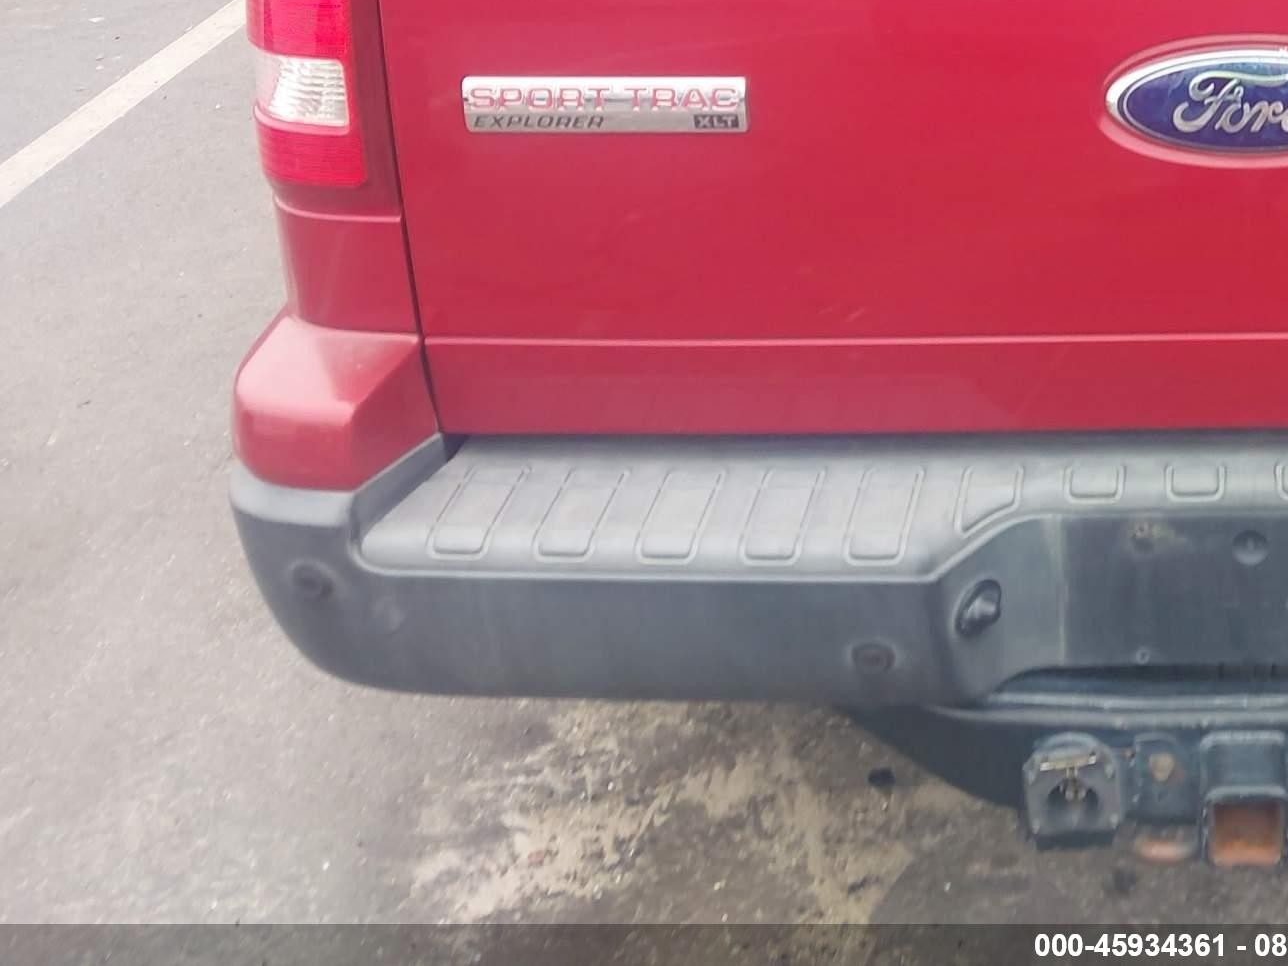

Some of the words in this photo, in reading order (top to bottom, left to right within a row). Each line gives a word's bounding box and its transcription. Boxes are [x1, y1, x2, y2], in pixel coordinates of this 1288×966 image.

[468, 86, 610, 111] SPORT
[623, 86, 739, 111] TRAC
[471, 113, 605, 129] EXPLORER
[695, 113, 739, 129] XLT
